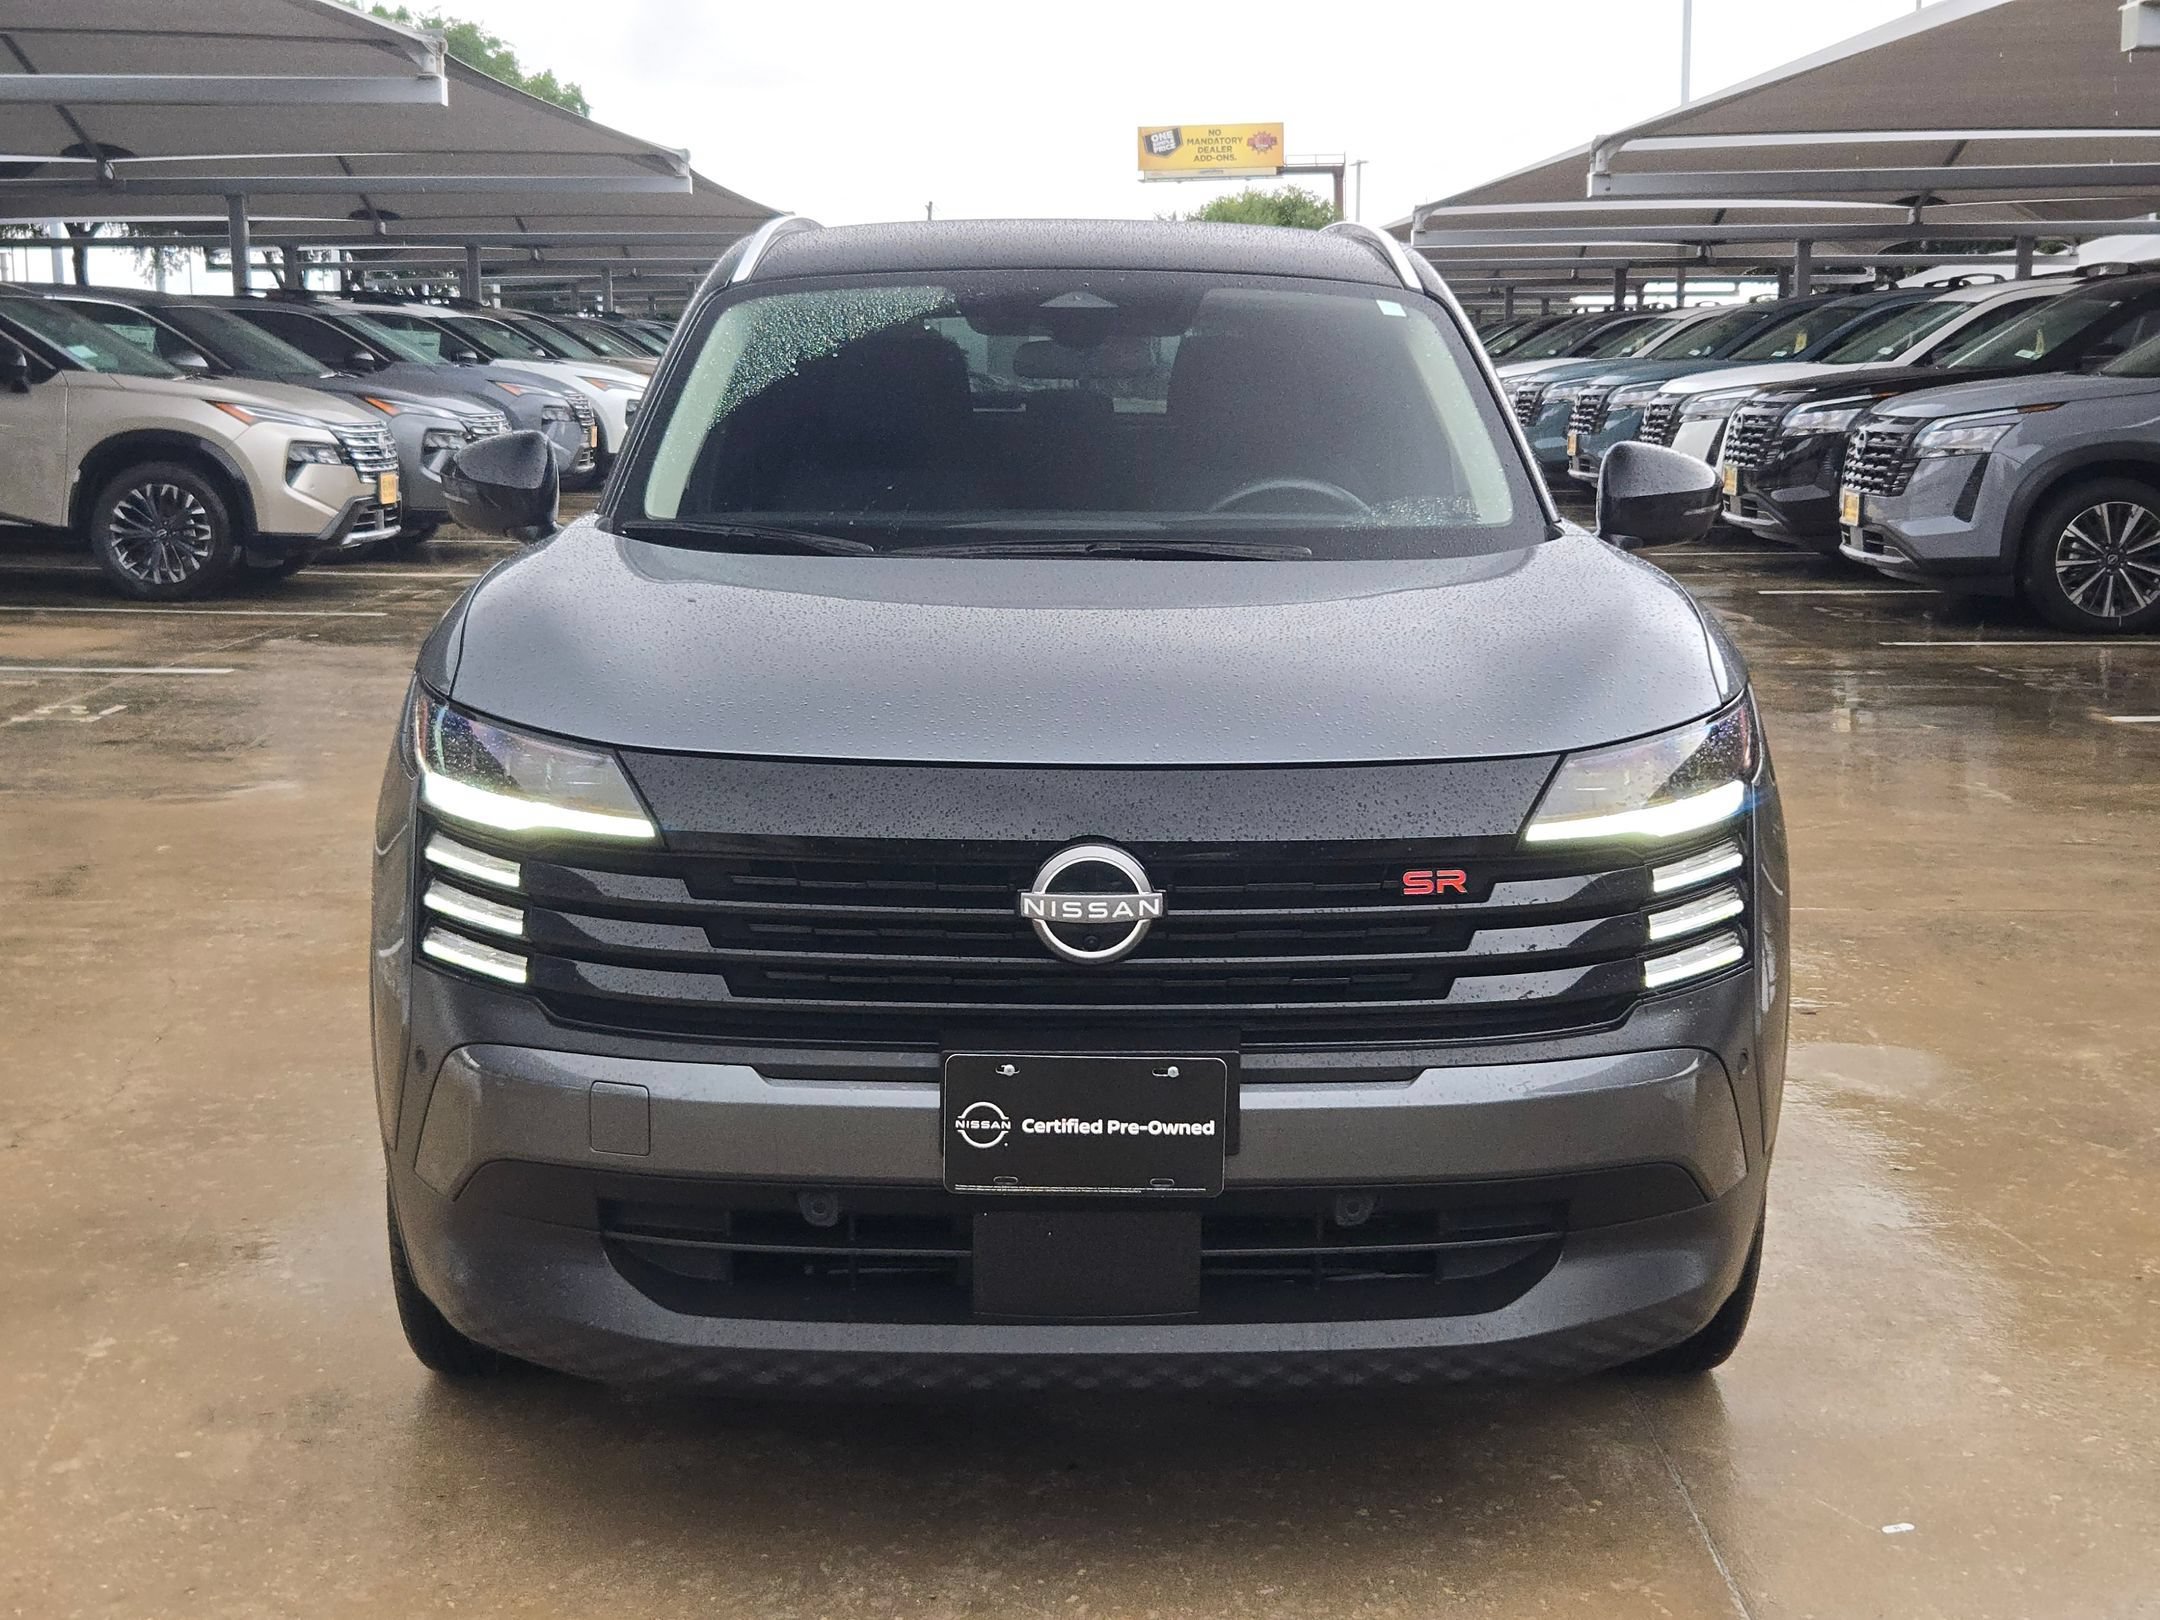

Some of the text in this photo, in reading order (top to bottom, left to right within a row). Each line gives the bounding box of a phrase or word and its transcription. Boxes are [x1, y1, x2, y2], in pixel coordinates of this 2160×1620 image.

[1151, 130, 1174, 142] ONE
[1187, 136, 1243, 145] MANDATORY
[1197, 145, 1233, 154] DEALER
[1193, 153, 1237, 162] ADD-ONS.
[1403, 870, 1467, 895] SR
[1023, 898, 1160, 919] NISSAN
[955, 1120, 1011, 1130] NISSAN
[1021, 1118, 1216, 1136] Certified Pre-Owned
